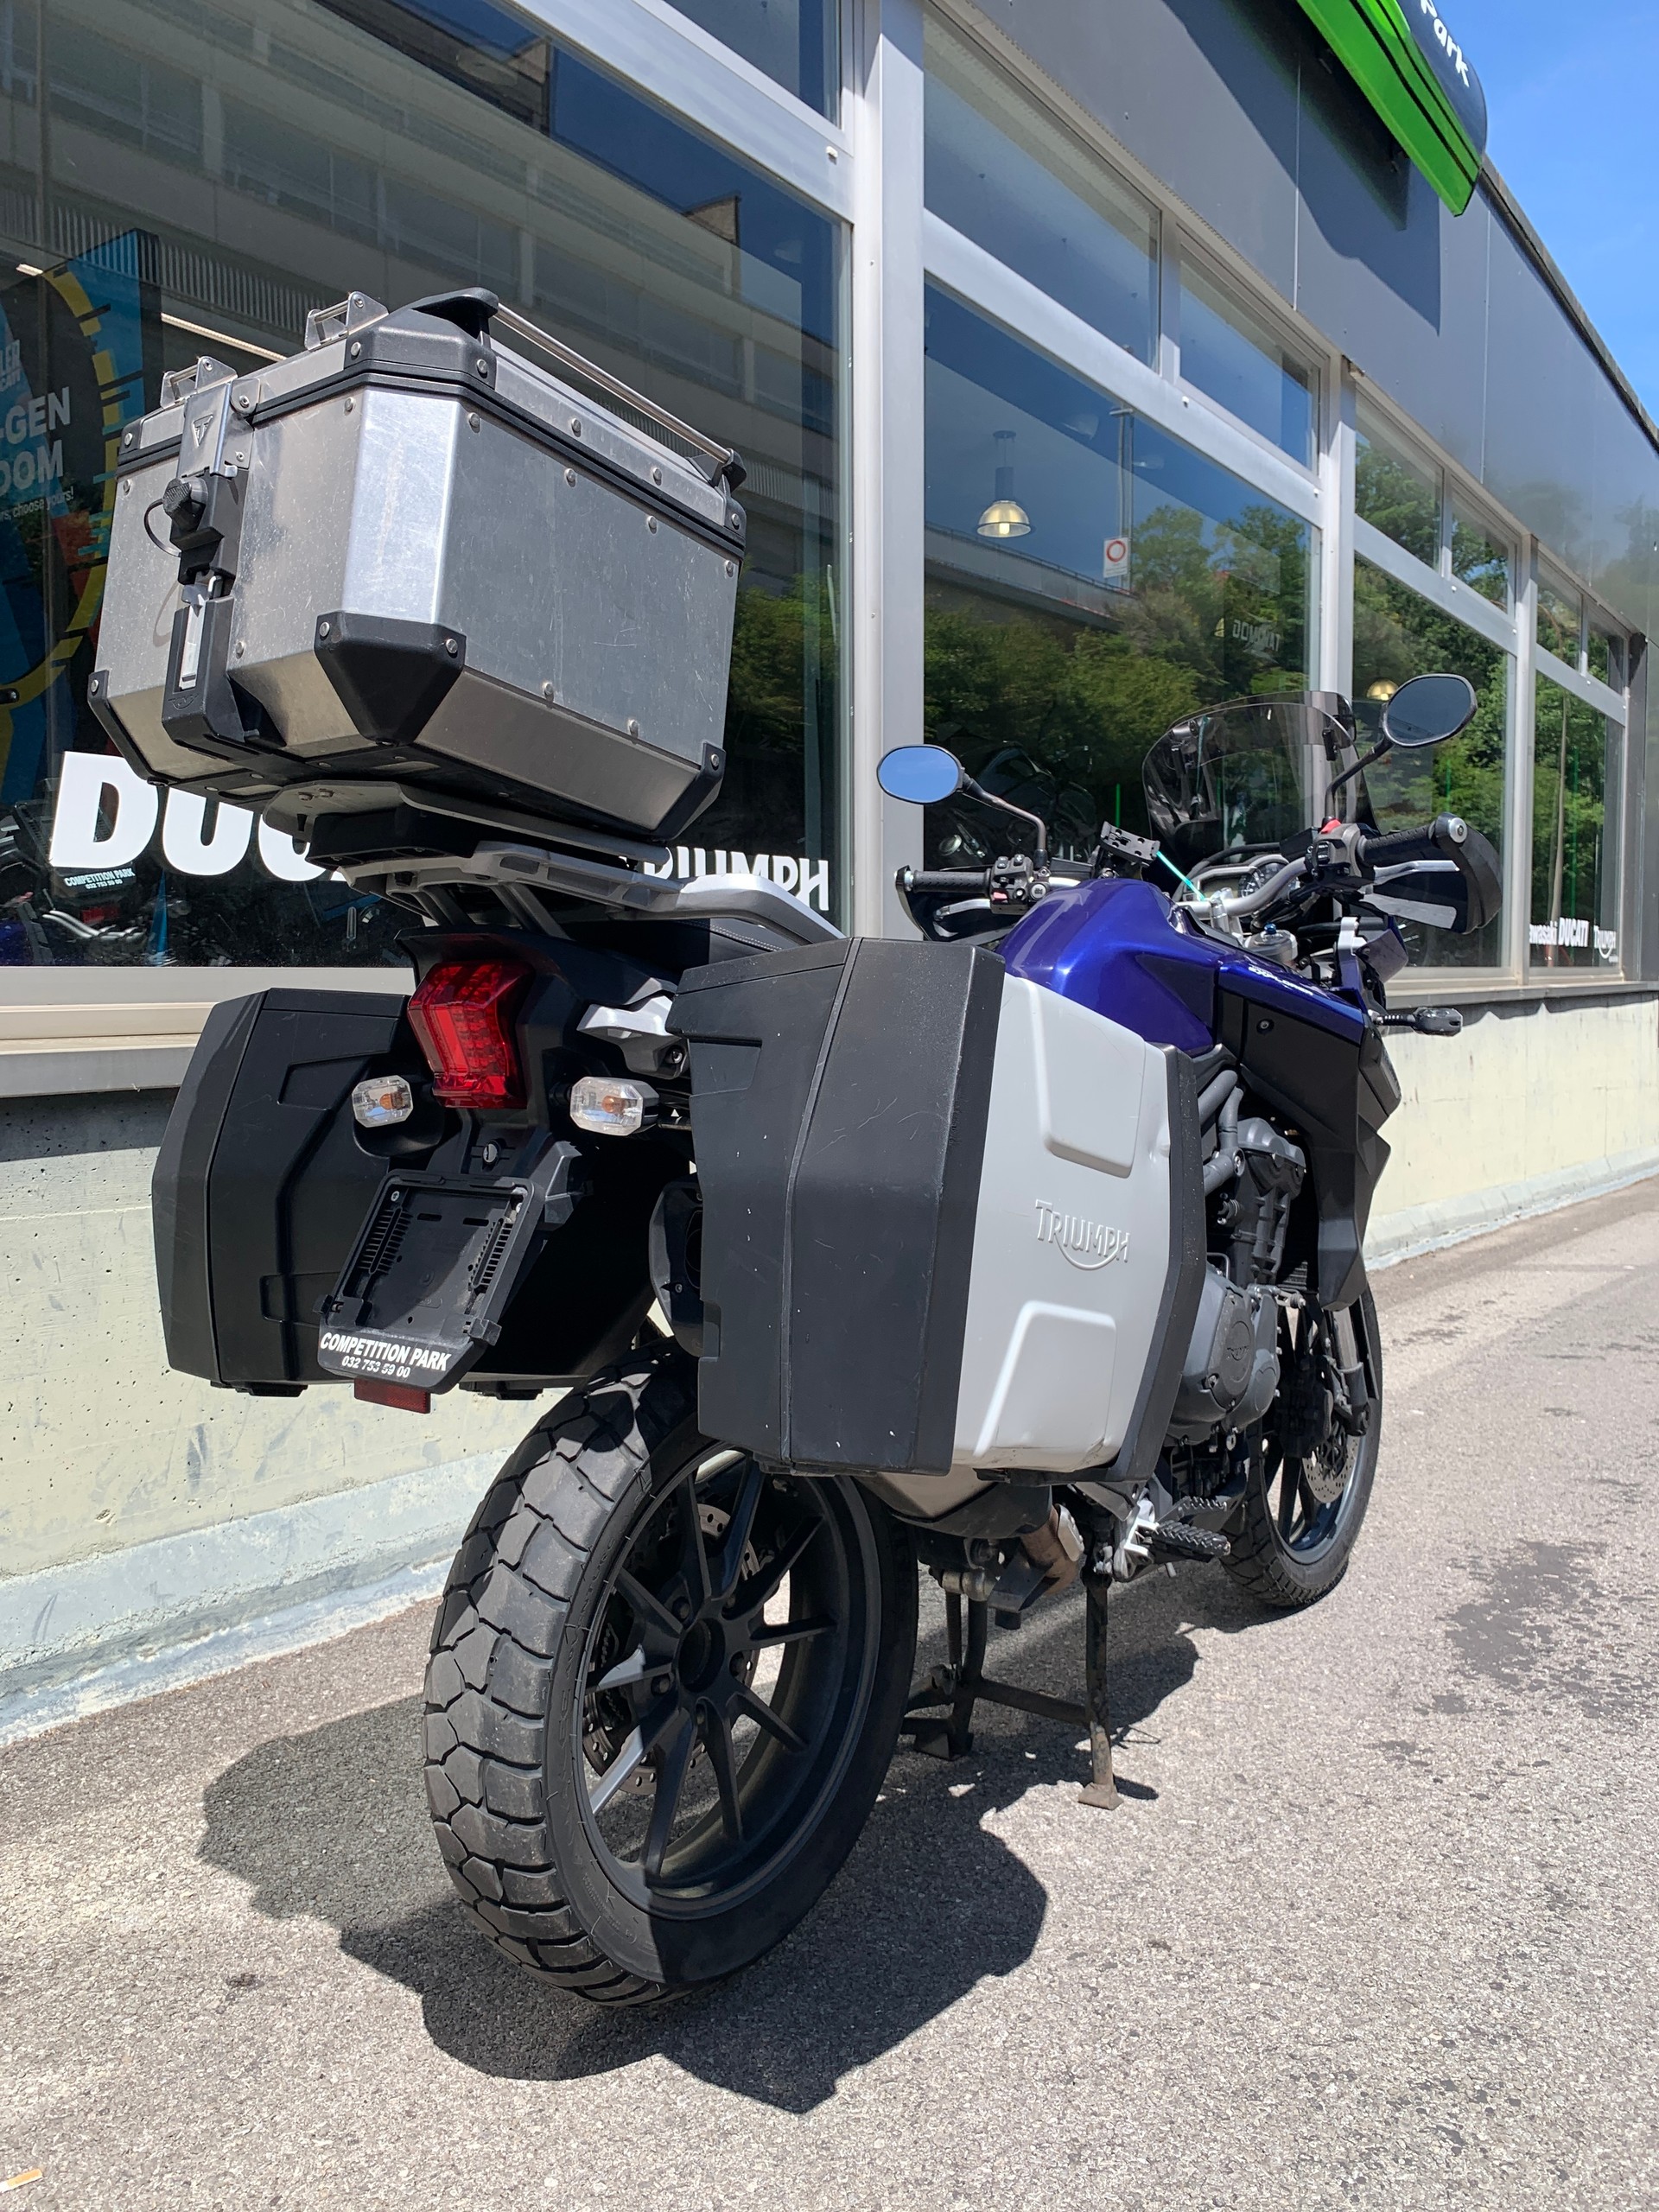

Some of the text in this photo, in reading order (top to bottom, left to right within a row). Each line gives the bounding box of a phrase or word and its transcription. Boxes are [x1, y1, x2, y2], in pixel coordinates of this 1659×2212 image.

[13, 499, 45, 518] choose
[46, 486, 74, 511] yours!
[64, 868, 136, 887] COMPETITION PARK
[1558, 917, 1590, 947] DUCATI
[1036, 1198, 1129, 1271] TRIUMPH
[320, 1332, 452, 1371] COMPETITION PARK
[341, 1356, 411, 1378] 032 753 59 00
